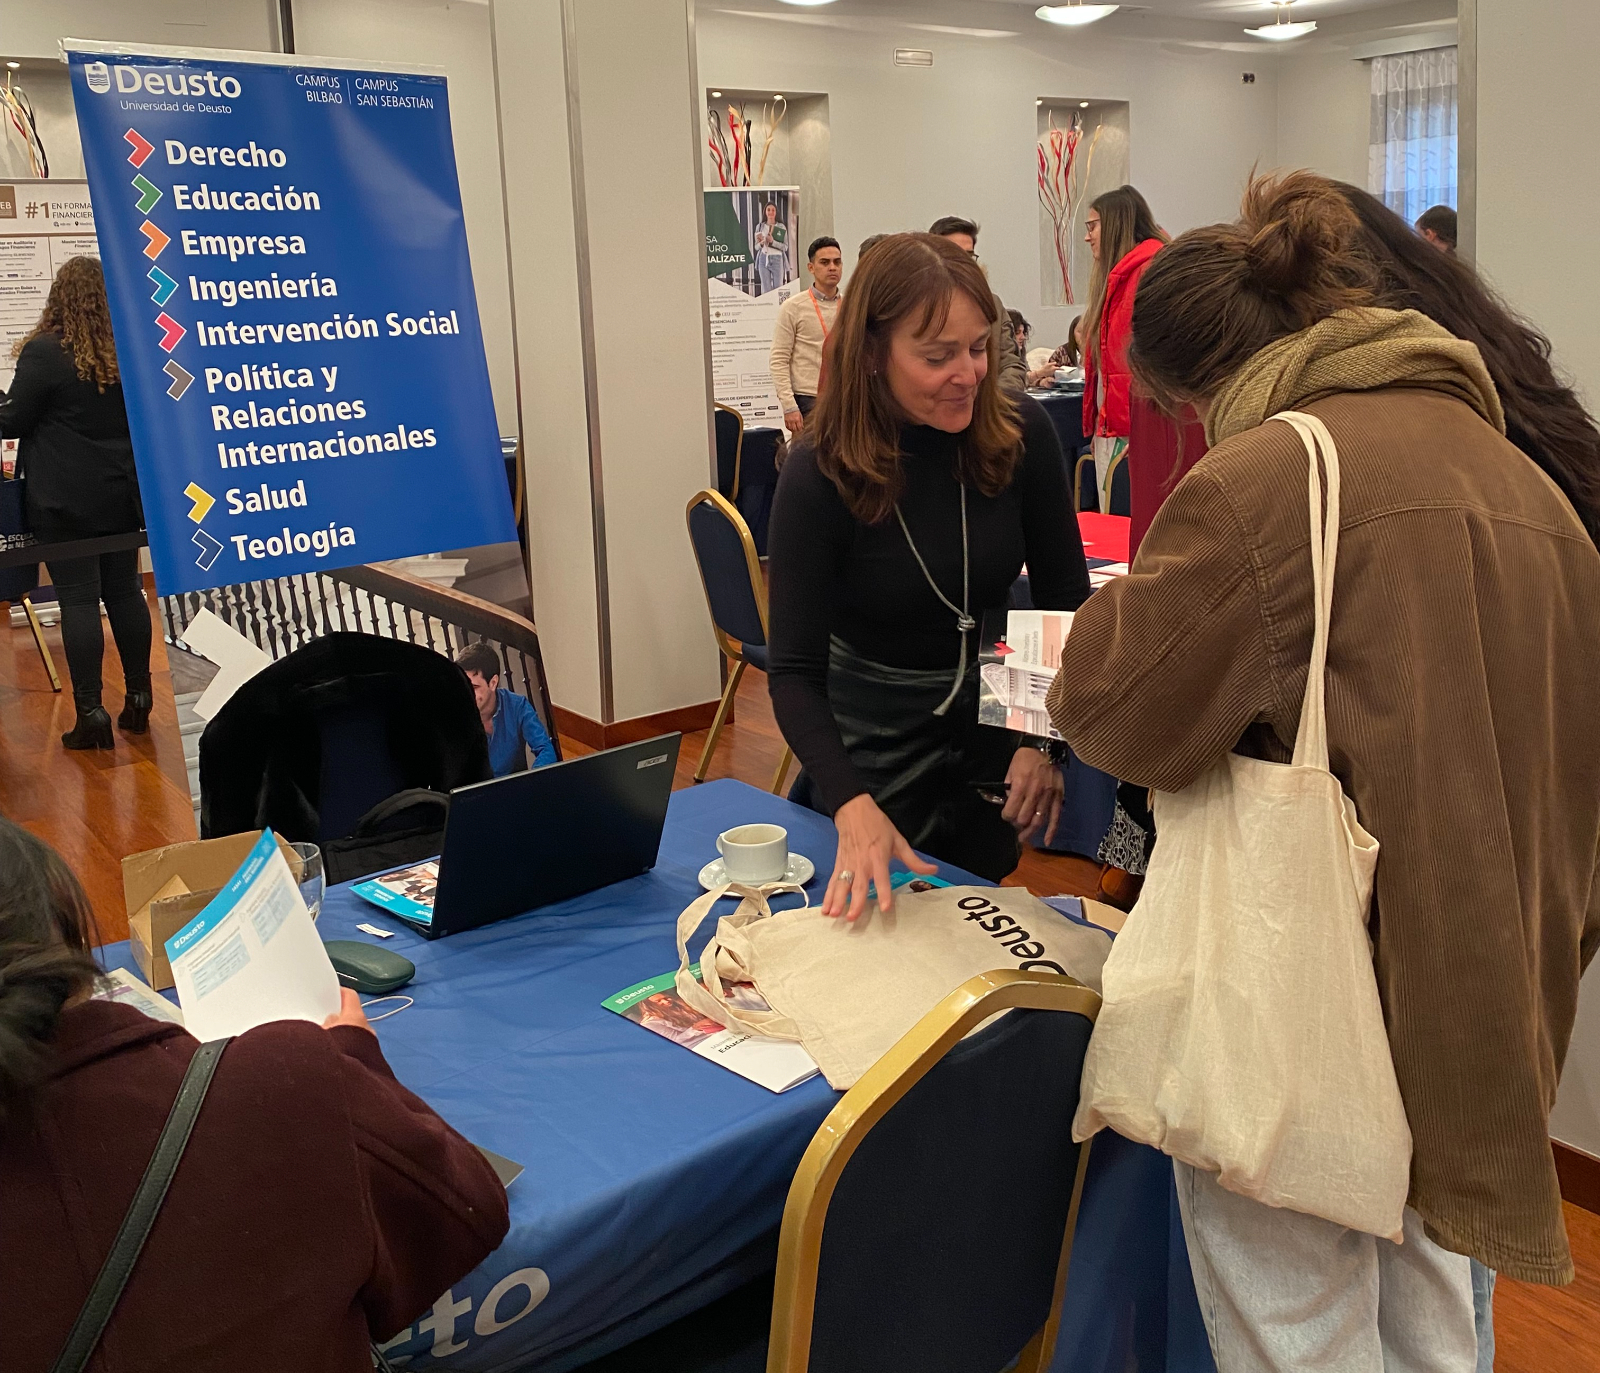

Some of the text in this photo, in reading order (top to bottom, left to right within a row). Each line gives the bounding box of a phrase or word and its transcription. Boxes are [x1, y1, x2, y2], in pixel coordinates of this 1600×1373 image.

[113, 65, 242, 99] Deusto
[295, 74, 340, 88] CAMPUS
[355, 78, 399, 92] CAMPUS
[120, 100, 232, 114] Universidad de Deusto
[306, 89, 343, 104] BILBAO
[356, 93, 434, 109] SAN SEBASTIÁN
[164, 139, 287, 168] Derecho
[25, 201, 50, 219] #1
[172, 184, 321, 211] Educación
[52, 211, 94, 219] FINANCIER
[181, 230, 307, 262] Empresa
[189, 272, 338, 306] Ingeniería
[197, 310, 460, 346] Intervención Social
[204, 362, 338, 394] Política y
[211, 398, 367, 431] Relaciones
[217, 424, 437, 469] Internacionales
[226, 480, 308, 515] Salud
[231, 522, 356, 561] Teología
[180, 920, 206, 945] Deusto
[622, 984, 655, 1001] Deusto
